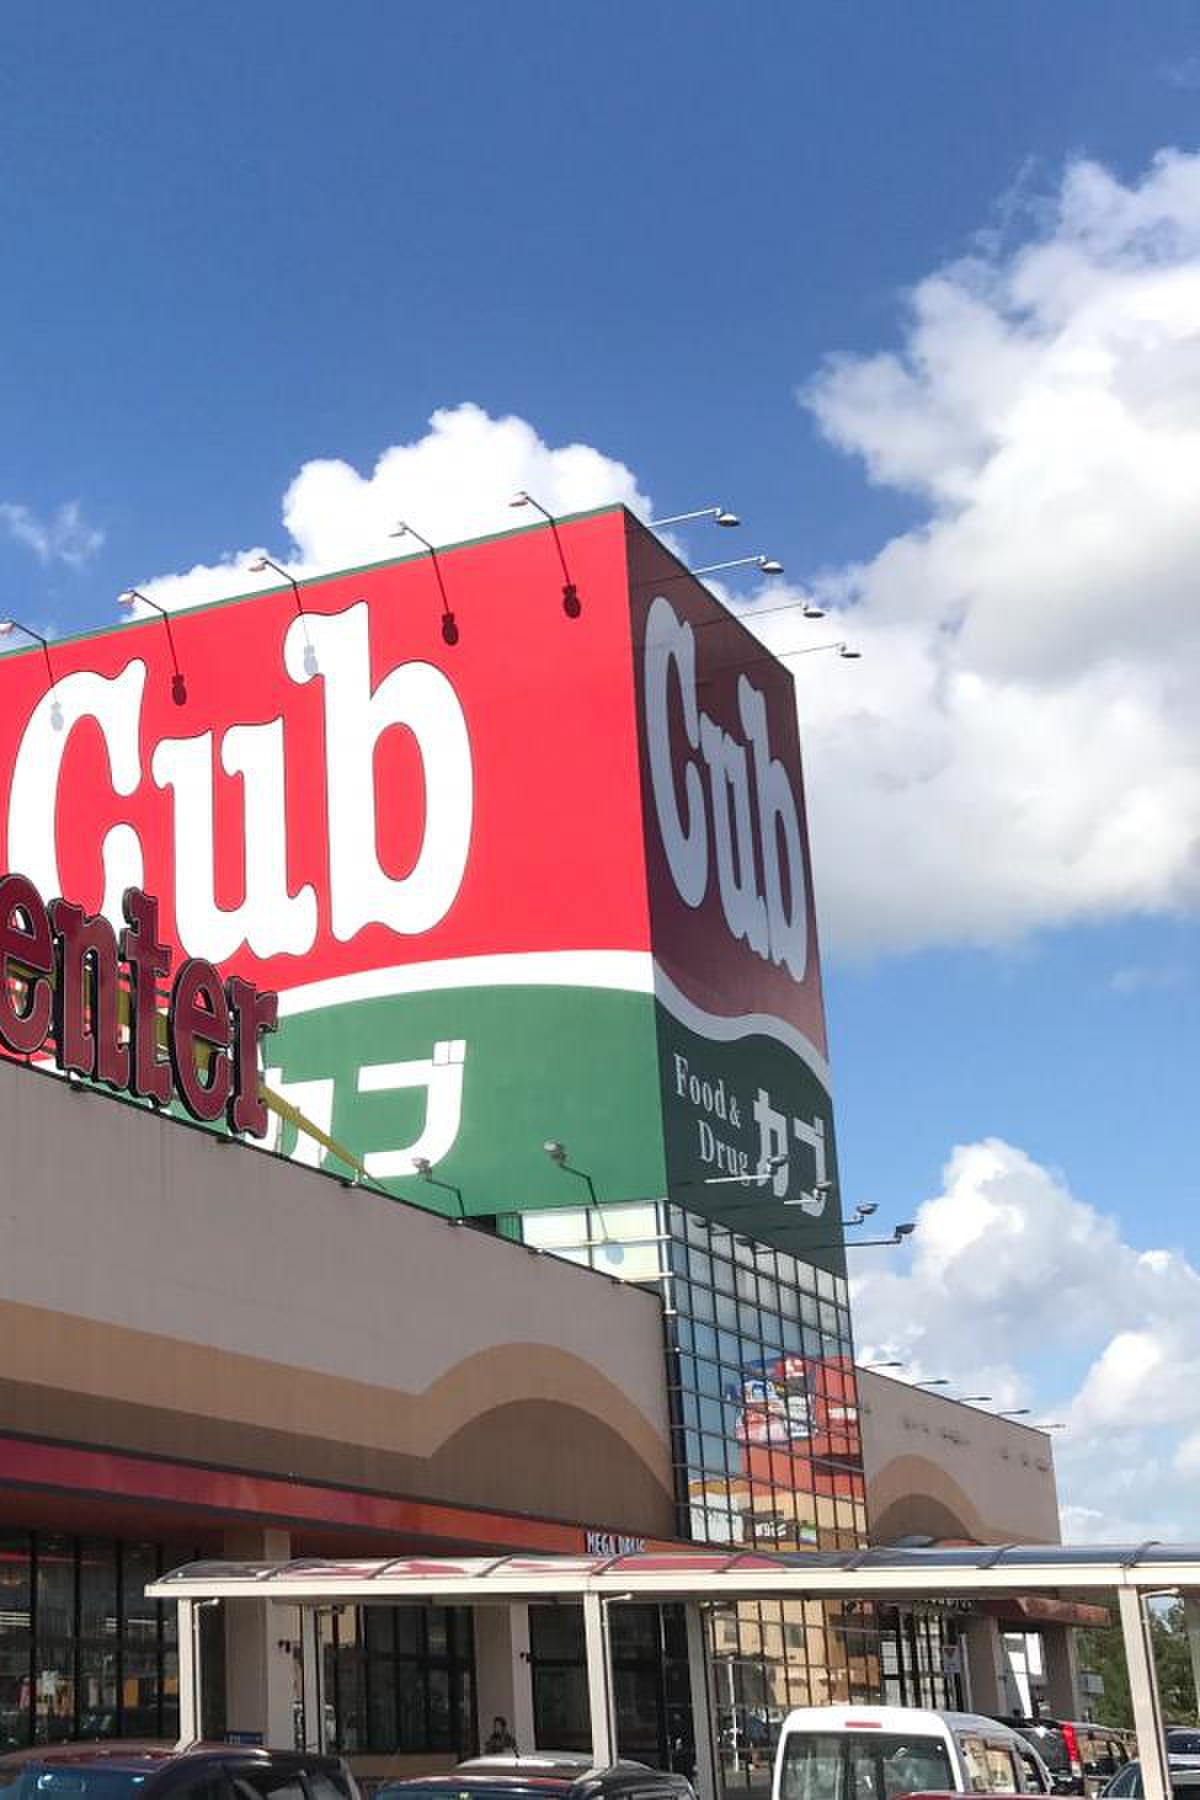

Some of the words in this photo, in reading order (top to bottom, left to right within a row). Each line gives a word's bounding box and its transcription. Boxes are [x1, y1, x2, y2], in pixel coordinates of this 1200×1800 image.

[7, 600, 473, 964] Cub
[644, 596, 808, 984] Cub
[674, 1053, 727, 1121] Food
[753, 1087, 827, 1217] カブ
[697, 1119, 751, 1187] Drug
